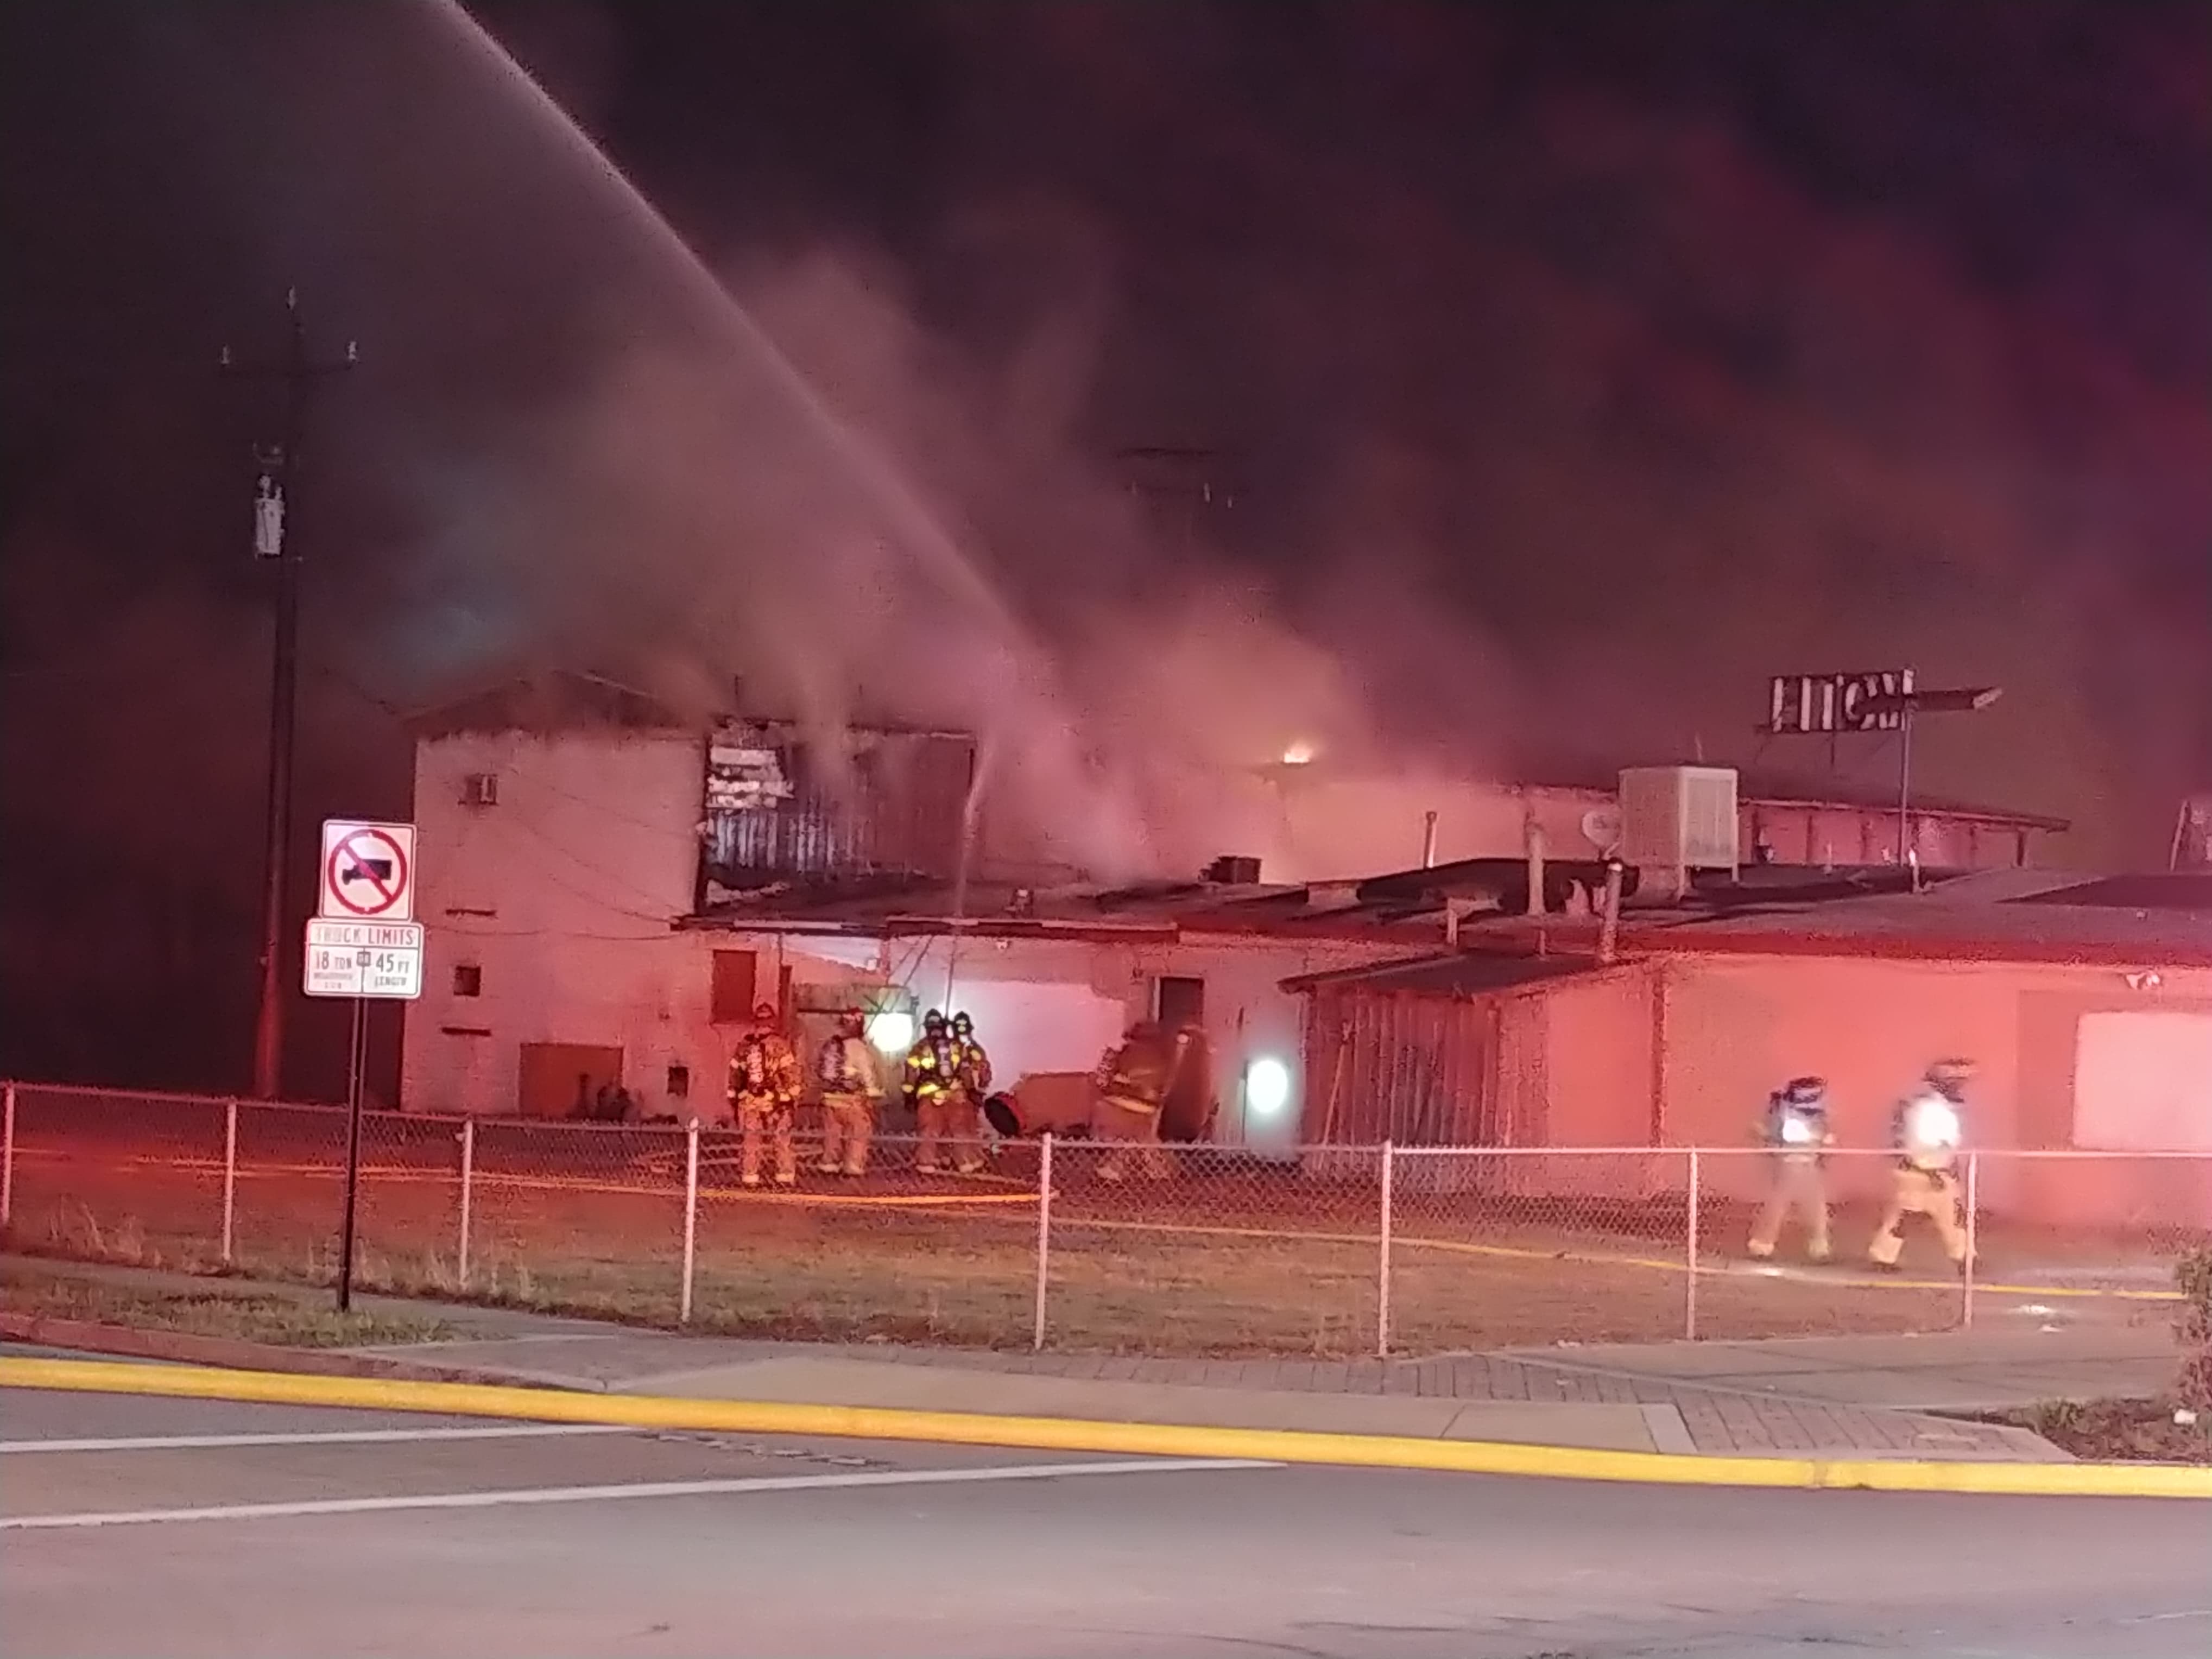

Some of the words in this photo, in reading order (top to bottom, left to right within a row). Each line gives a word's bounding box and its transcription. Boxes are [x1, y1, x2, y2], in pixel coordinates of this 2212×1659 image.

[315, 927, 361, 943] TRUCK
[368, 928, 413, 945] LIMITS
[316, 951, 329, 970] 18
[334, 957, 352, 970] TON
[376, 953, 394, 972] 45
[397, 961, 409, 973] FT
